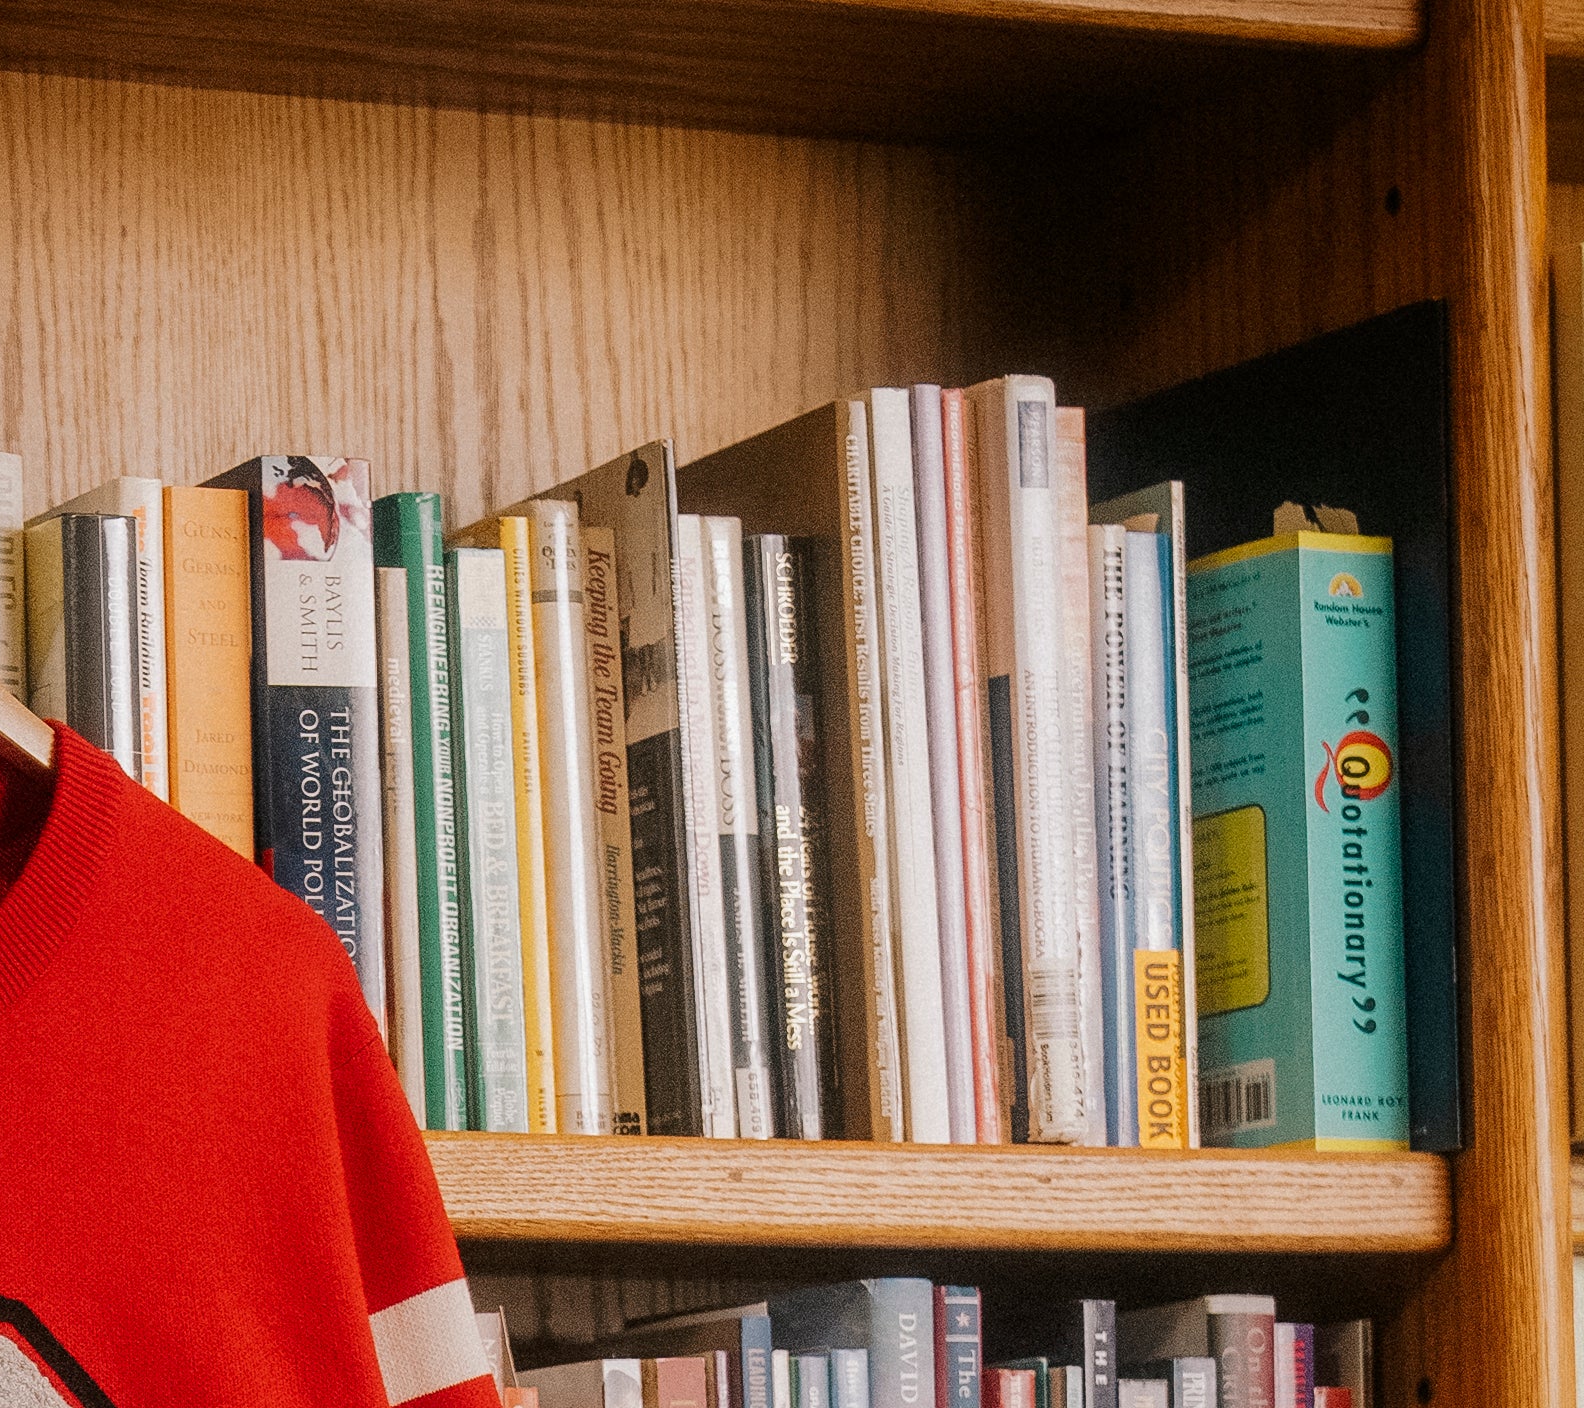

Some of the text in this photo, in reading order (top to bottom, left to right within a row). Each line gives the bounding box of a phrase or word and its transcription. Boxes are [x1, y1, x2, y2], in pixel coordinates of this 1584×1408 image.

[299, 574, 320, 672] & SMITH
[325, 575, 345, 651] BAYLIS
[300, 709, 320, 743] OF
[587, 550, 620, 814] Keeping the Team Going
[330, 707, 359, 967] THE GLOBALIZATIO
[1145, 961, 1176, 1139] USED BOOK
[897, 1313, 919, 1402] DAVID
[957, 1350, 976, 1392] The
